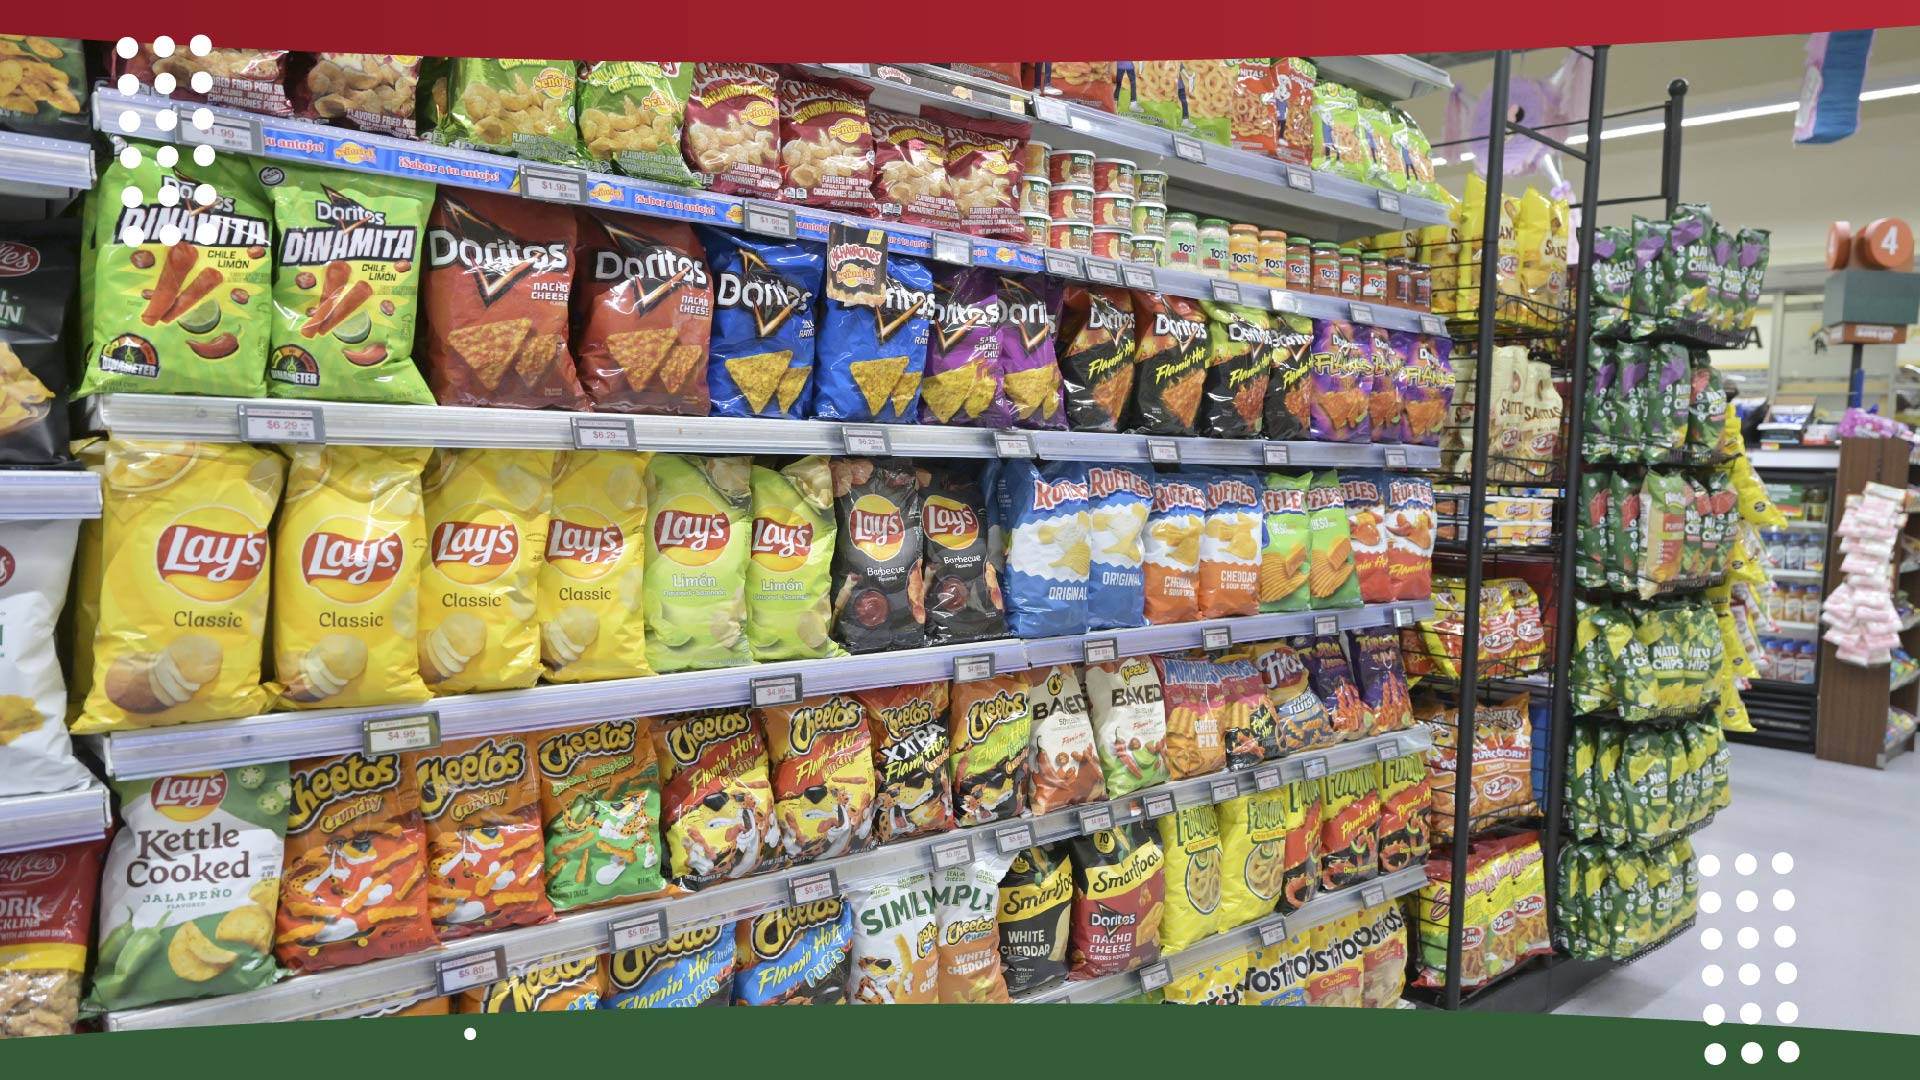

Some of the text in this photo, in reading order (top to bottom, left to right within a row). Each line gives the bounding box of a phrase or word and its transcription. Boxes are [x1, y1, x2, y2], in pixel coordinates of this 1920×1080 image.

[278, 137, 325, 154] antojo!
[461, 169, 500, 182] antojo!
[318, 204, 385, 226] Doritos
[685, 203, 716, 216] antojo!
[283, 228, 415, 264] DINAMITA
[1880, 225, 1899, 256] 4
[207, 250, 236, 260] CHILE
[429, 230, 568, 270] Doritos
[829, 244, 882, 270] CHICHARRONES
[218, 258, 249, 269] LIMÓN
[361, 263, 386, 273] CHILE
[596, 249, 707, 285] Doritos
[370, 270, 397, 281] LIMÓN
[531, 291, 569, 301] CHEESE
[533, 282, 568, 292] NACHO
[718, 273, 813, 311] Doritos
[681, 295, 709, 306] NACHO
[679, 304, 709, 316] CHEESE
[1156, 314, 1208, 339] Doritos
[1192, 346, 1206, 365] Hot
[267, 419, 298, 430] $6.29
[593, 430, 617, 440] $6.29
[1089, 468, 1153, 498] RUFFLES
[1153, 484, 1207, 512] RUFFLES
[1208, 480, 1257, 509] RUFFLES
[854, 510, 900, 547] Lay's
[928, 505, 976, 536] Lay's
[659, 510, 727, 550] Lay's
[754, 520, 811, 558] Lay's
[436, 522, 515, 567] Lay's
[547, 519, 619, 565] Lay's
[164, 525, 266, 581] Lay's
[308, 533, 398, 586] Lay's
[944, 554, 982, 566] Barbecue
[673, 573, 717, 588] Limón
[867, 565, 905, 578] Barbecue
[1102, 571, 1142, 586] ORIGINAL
[1221, 570, 1257, 582] CHEDDAR
[559, 586, 612, 601] Classic
[762, 579, 804, 591] Limón
[1049, 586, 1088, 601] ORIGINAL
[442, 592, 502, 607] Classic
[173, 610, 243, 628] Classic
[319, 611, 384, 628] Classic
[1653, 646, 1680, 658] NATU
[1652, 658, 1684, 671] CHIPS
[766, 688, 788, 698] $4.99
[1111, 683, 1164, 708] BAKED
[1033, 693, 1088, 721] BAKED
[883, 700, 933, 741] Cheetos
[968, 691, 1028, 743] Cheetos
[388, 729, 417, 742] $4.99
[791, 700, 861, 754] Cheetos
[668, 711, 749, 764] Cheetos
[833, 731, 856, 753] Hot
[881, 721, 946, 763] XXTRA
[1198, 735, 1219, 749] FIX
[540, 721, 635, 776] Cheetos
[689, 733, 755, 797] Flamin' Hot
[417, 742, 524, 819] Cheetos
[1485, 782, 1501, 795] $2
[156, 774, 224, 809] Lay's
[320, 794, 383, 834] Crunchy
[451, 788, 506, 822] Crunchy
[137, 823, 240, 861] Kettle
[1099, 832, 1109, 844] 70
[126, 851, 251, 888] Cooked
[1092, 850, 1161, 894] Smartfood
[143, 887, 233, 904] JALAPEÑO
[804, 884, 824, 896] $5.89
[751, 898, 841, 960] Cheetos
[1091, 913, 1136, 927] Doritos
[1493, 915, 1506, 930] $2
[627, 927, 650, 938] $5.89
[946, 917, 995, 945] Cheetos
[1007, 929, 1045, 944] WHITE
[1092, 932, 1132, 944] NACHO
[758, 923, 838, 992] Flamin' Hot
[955, 949, 991, 965] WHITE
[1000, 943, 1051, 957] CHEDDAR
[1089, 943, 1132, 954] CHEESE
[459, 966, 485, 979] $5.89
[688, 952, 713, 982] Hot
[804, 948, 845, 989] Puffs
